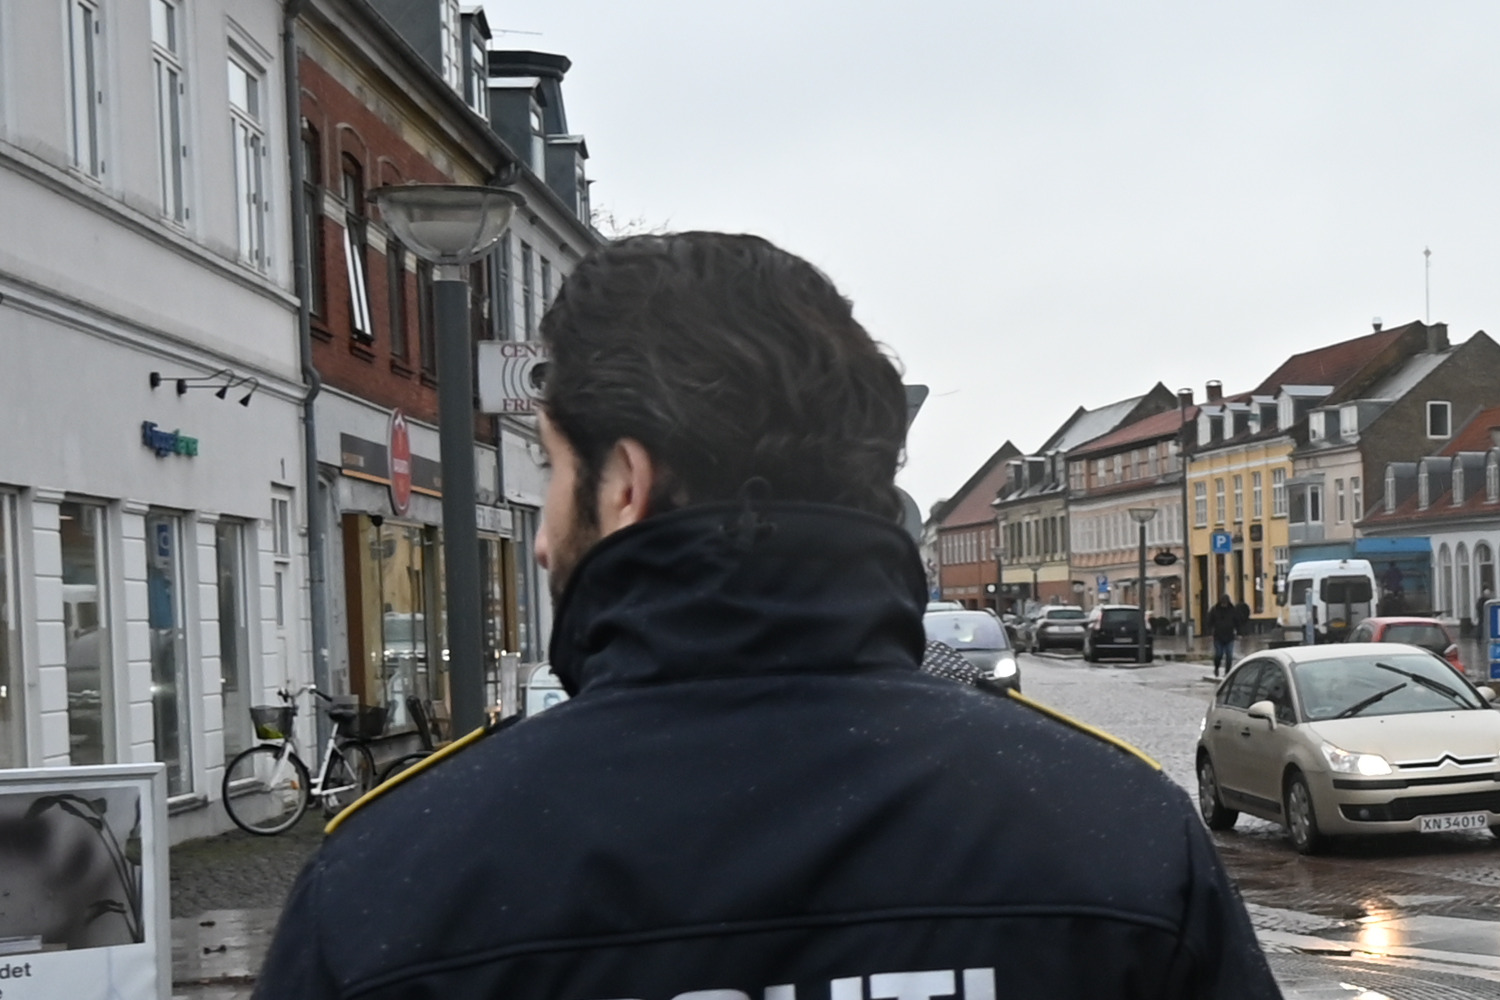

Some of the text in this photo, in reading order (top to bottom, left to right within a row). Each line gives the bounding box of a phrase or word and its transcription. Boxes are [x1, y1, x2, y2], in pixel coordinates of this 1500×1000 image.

[1216, 535, 1227, 549] P
[1423, 814, 1486, 830] XN 34019
